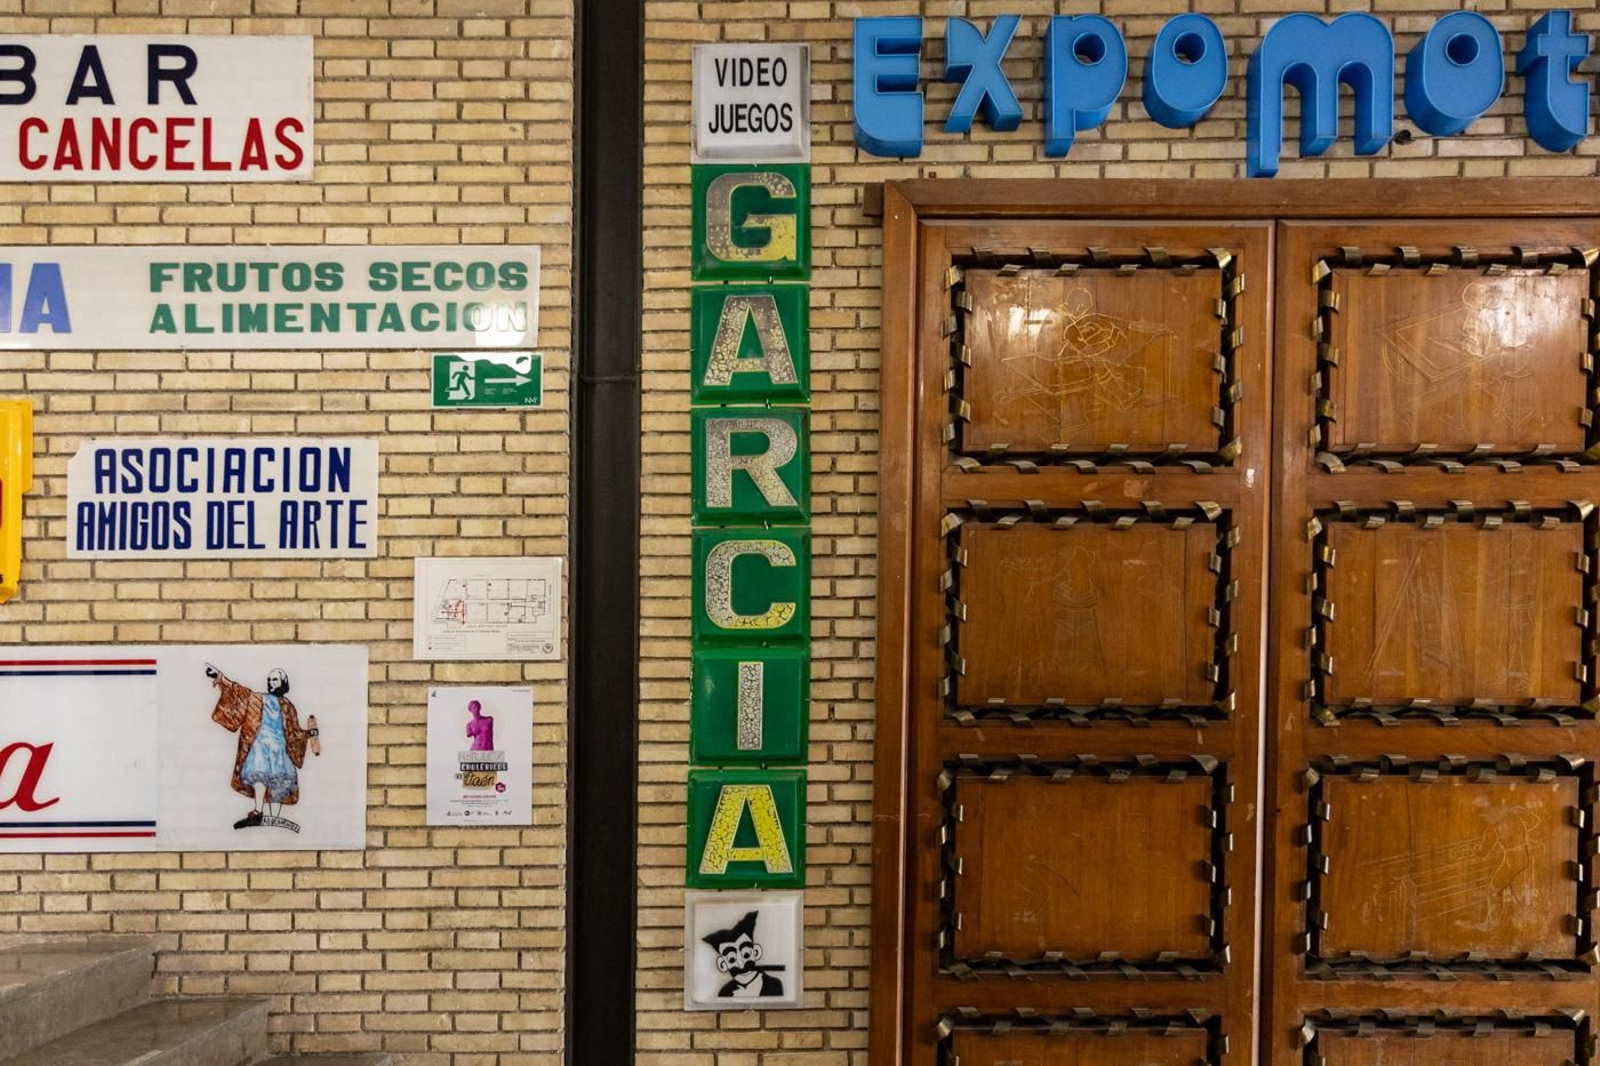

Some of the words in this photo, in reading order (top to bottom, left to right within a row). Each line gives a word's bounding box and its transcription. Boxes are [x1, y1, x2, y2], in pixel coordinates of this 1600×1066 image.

[0, 44, 198, 105] BAR
[714, 57, 787, 88] VIDEO
[708, 102, 793, 134] JUEGOS
[19, 116, 305, 172] CANCELAS
[0, 263, 72, 333] A
[150, 262, 343, 293] FRUTOS
[369, 261, 528, 292] SECOS
[150, 300, 528, 334] ALIMENTACION
[94, 446, 352, 494] ASOCIACION
[76, 500, 192, 550] AMIGOS
[206, 500, 266, 550] DEL
[279, 499, 367, 549] ARTE
[698, 171, 800, 875] GARCIA
